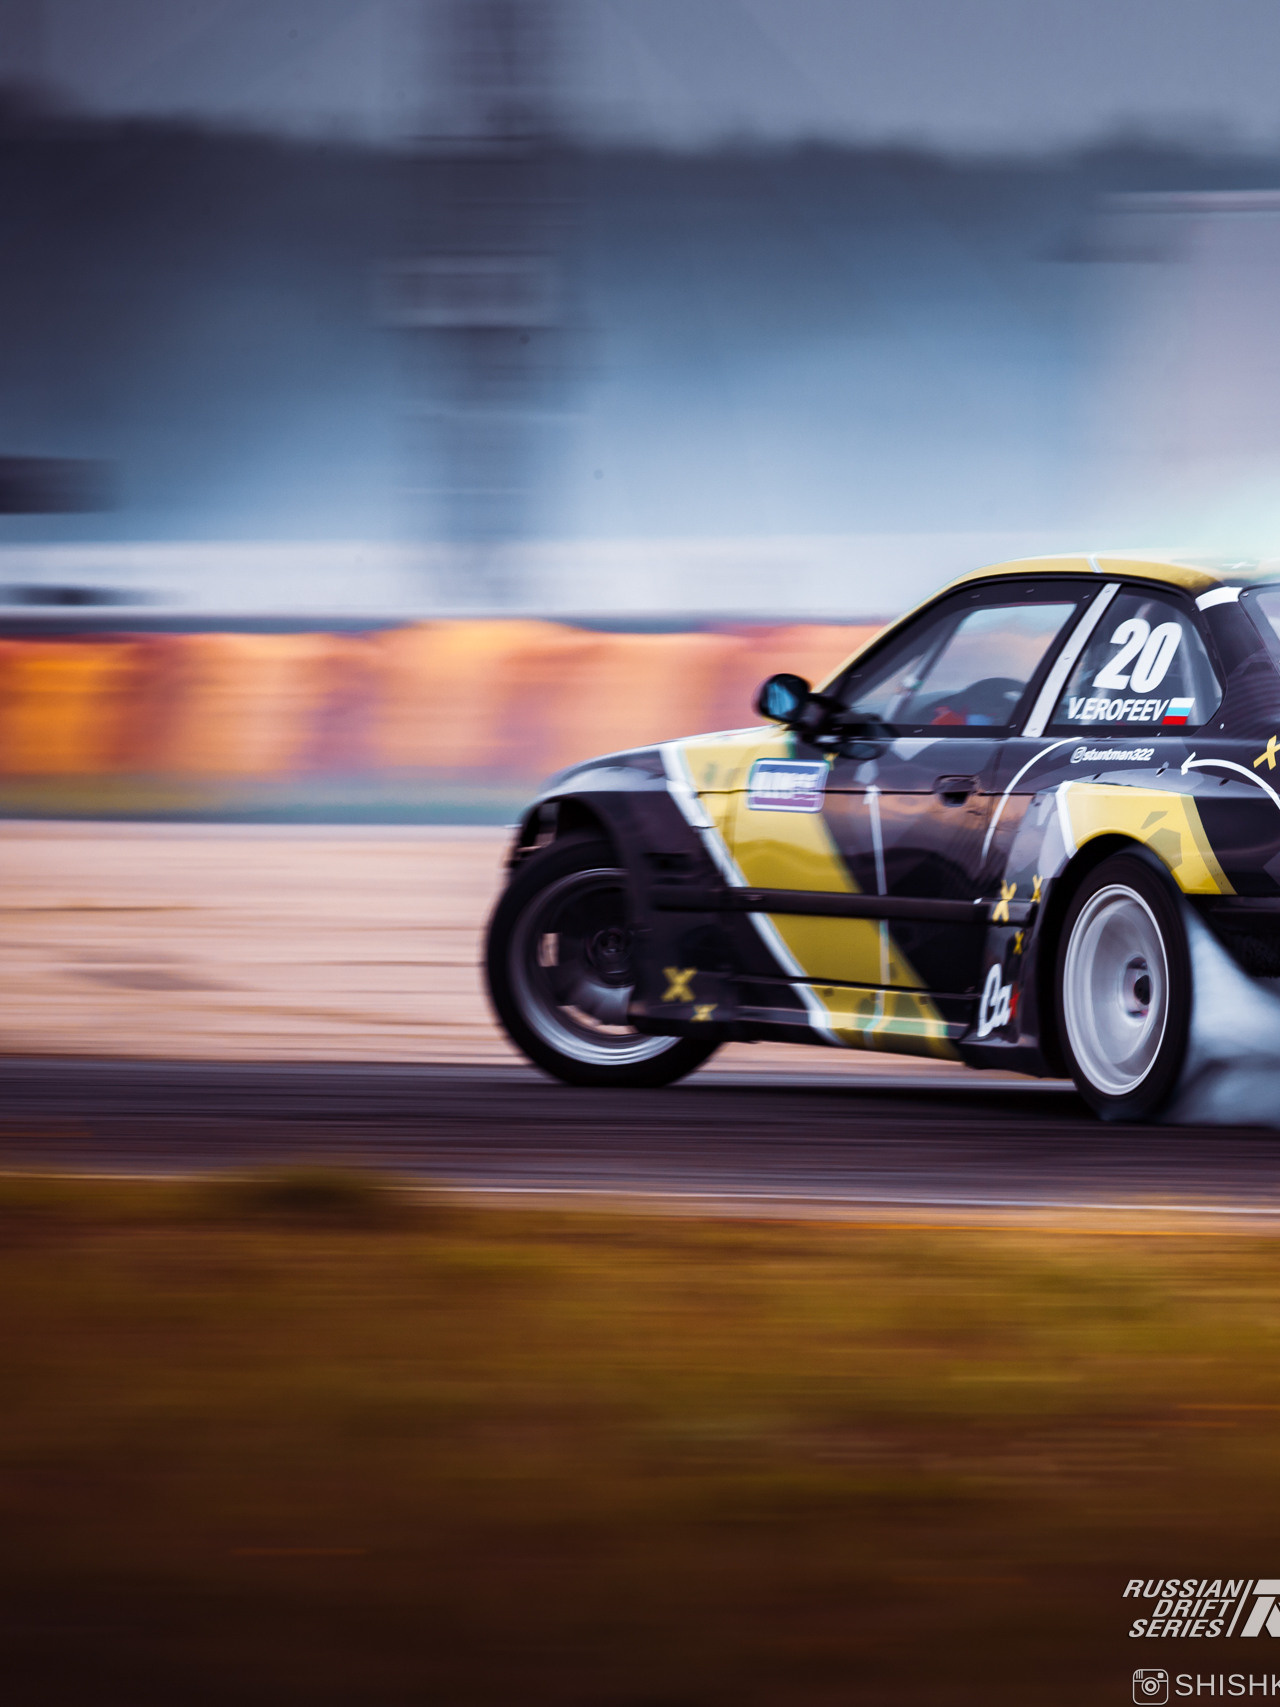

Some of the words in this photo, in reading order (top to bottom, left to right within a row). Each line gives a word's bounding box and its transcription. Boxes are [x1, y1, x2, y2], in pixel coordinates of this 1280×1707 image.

[1092, 617, 1183, 694] 20
[1067, 696, 1170, 721] V.EROFEEV
[1069, 746, 1155, 764] @stuntman322
